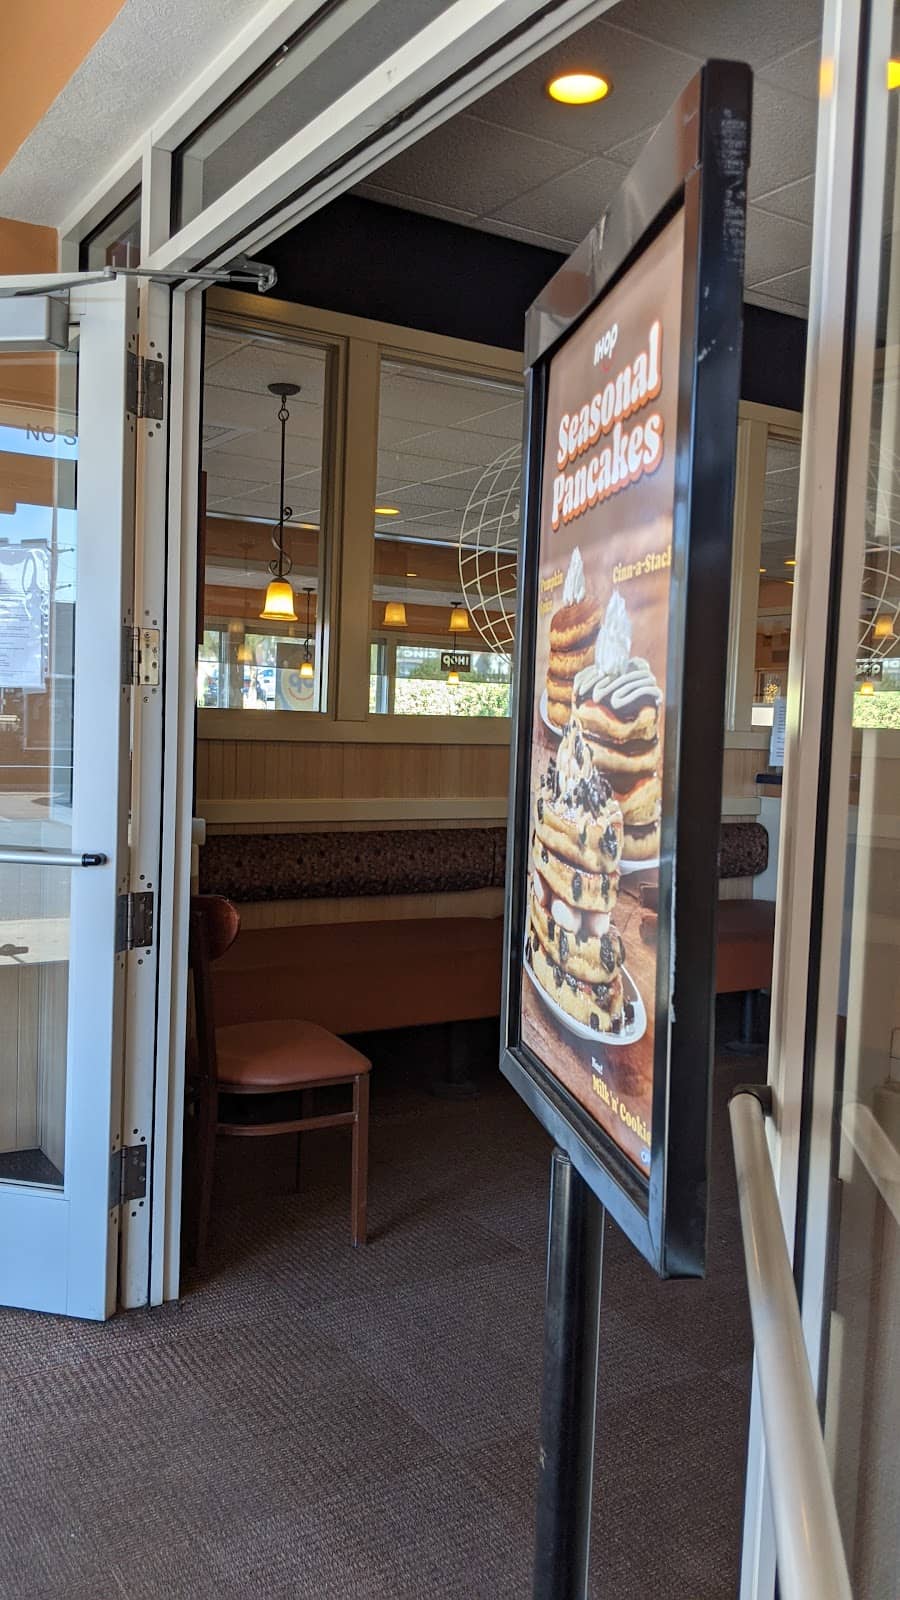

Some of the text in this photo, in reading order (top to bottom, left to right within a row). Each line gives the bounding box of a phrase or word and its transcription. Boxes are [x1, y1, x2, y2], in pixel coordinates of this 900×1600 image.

[593, 323, 618, 366] IHOP
[556, 320, 661, 469] Seasonal
[26, 423, 56, 443] NO
[551, 414, 664, 531] Pancakes
[592, 1074, 610, 1106] Milk
